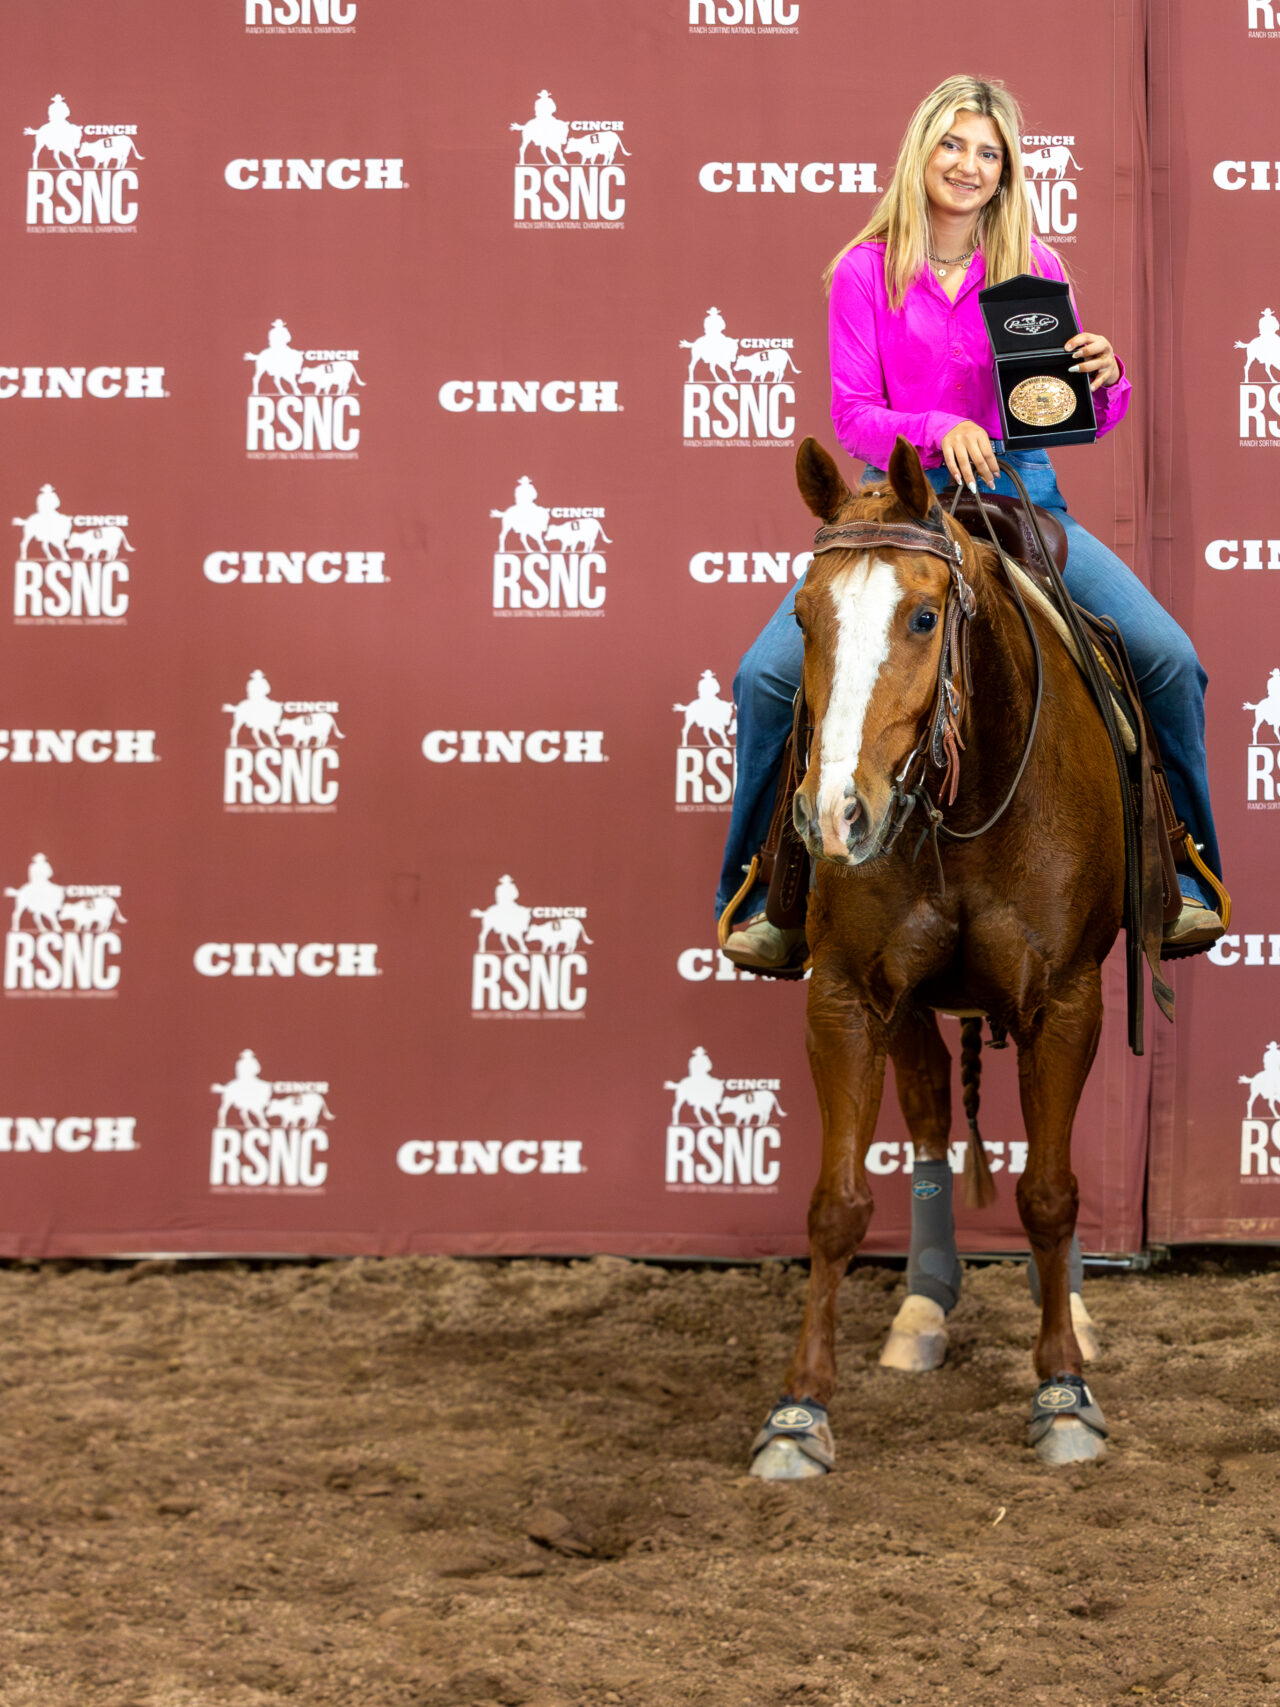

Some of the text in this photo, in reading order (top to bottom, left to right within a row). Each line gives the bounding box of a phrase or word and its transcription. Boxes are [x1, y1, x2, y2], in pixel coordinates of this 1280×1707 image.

[84, 125, 137, 135] CINCH
[571, 121, 624, 131] CINCH
[1022, 136, 1075, 146] CINCH
[225, 159, 402, 189] CINCH
[699, 162, 875, 193] CINCH
[25, 170, 139, 224] RSNC
[513, 165, 626, 221] RSNC
[305, 350, 359, 360] CINCH
[740, 338, 794, 348] CINCH
[439, 381, 617, 412] CINCH
[682, 383, 796, 438] RSNC
[246, 396, 361, 451] RSNC
[74, 515, 128, 526] CINCH
[551, 507, 605, 517] CINCH
[204, 552, 384, 583] CINCH
[492, 553, 607, 609] RSNC
[689, 552, 814, 583] CIN
[13, 561, 129, 617] RSNC
[0, 730, 155, 763] INCH
[423, 731, 603, 762] CINCH
[224, 748, 339, 804] RSNC
[675, 747, 737, 803] RS
[4, 932, 121, 989] RSNC
[194, 943, 376, 976] CINCH
[471, 953, 588, 1010] RSNC
[726, 1079, 780, 1090] CINCH
[0, 1117, 136, 1152] INCH
[210, 1128, 329, 1186] RSNC
[397, 1141, 581, 1174] CINCH
[665, 1126, 781, 1184] RSNC
